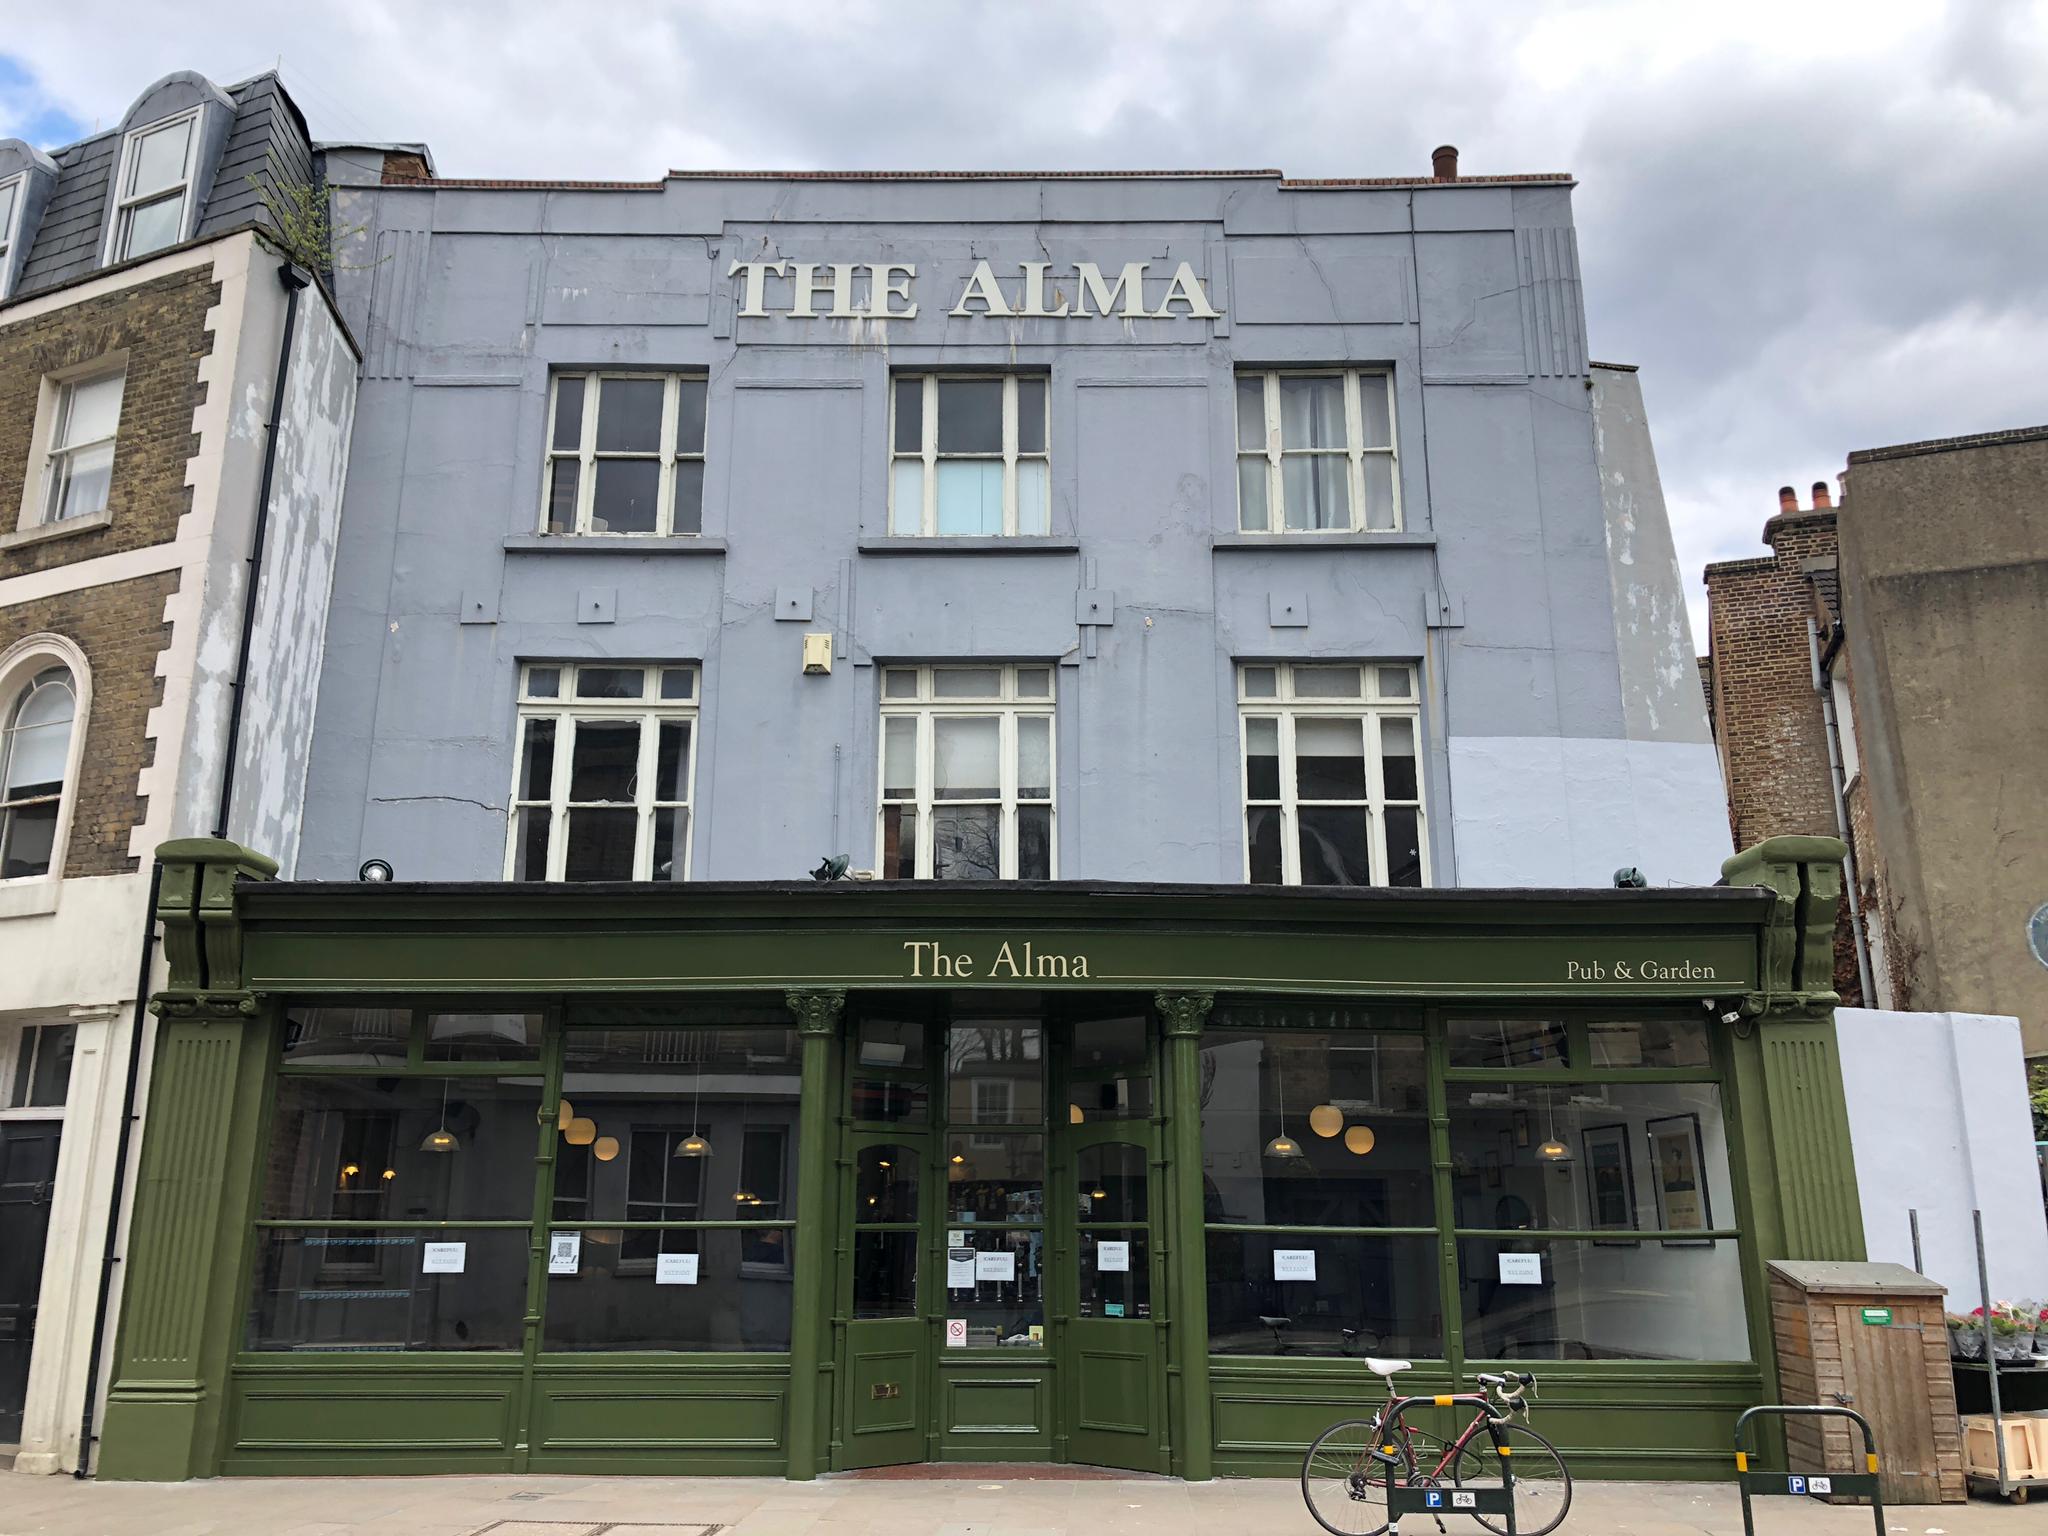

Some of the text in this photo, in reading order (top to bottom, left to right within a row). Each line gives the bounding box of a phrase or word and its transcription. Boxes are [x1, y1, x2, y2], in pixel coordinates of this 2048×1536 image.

[728, 258, 1221, 319] THE ALMA
[903, 941, 1090, 978] The Alma
[1567, 960, 1716, 980] Pub & Garden
[1792, 1478, 1803, 1492] P
[1429, 1492, 1440, 1505] P
